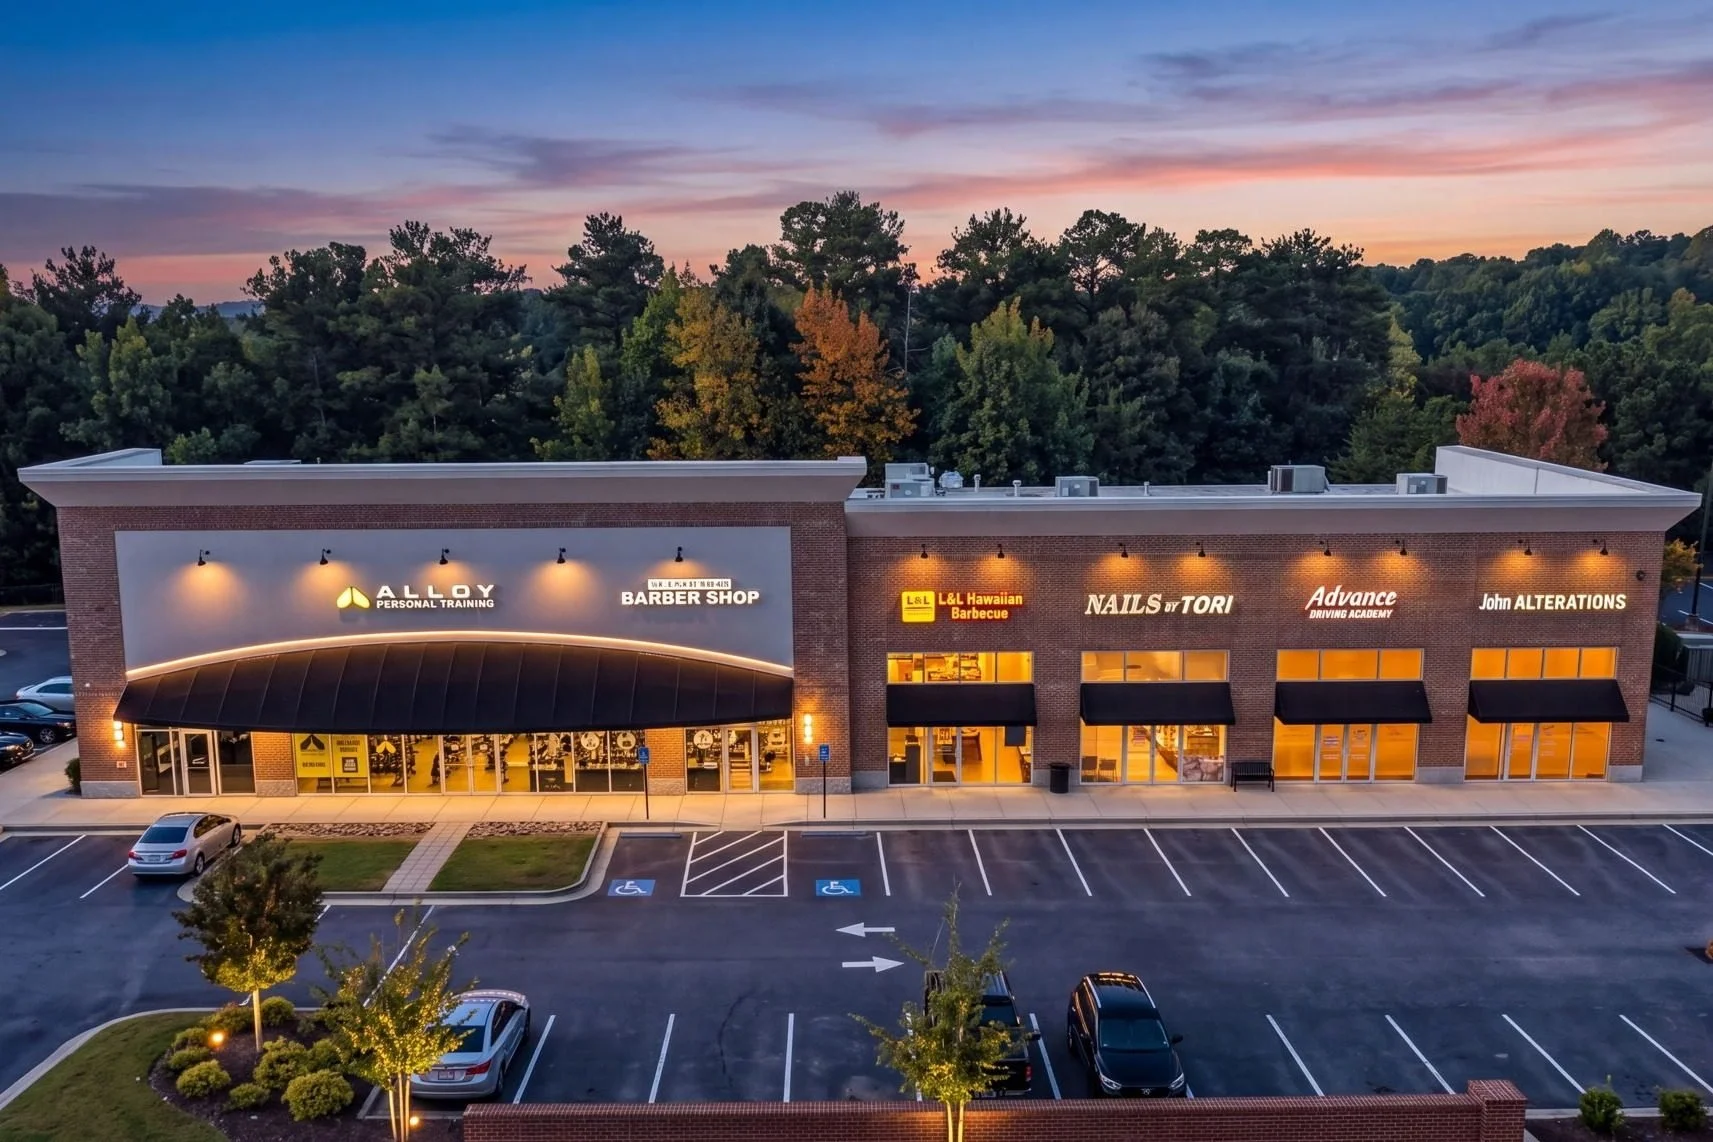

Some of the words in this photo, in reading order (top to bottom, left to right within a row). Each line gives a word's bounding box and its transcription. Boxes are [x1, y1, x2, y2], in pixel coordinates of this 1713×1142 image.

[376, 584, 495, 599] ALLOY
[621, 591, 701, 605] BARBER
[706, 590, 760, 605] SHOP
[938, 592, 964, 605] L&L
[967, 591, 1023, 605] Hawaiian
[1304, 584, 1397, 611] Advance
[376, 600, 437, 609] PERSONAL
[439, 599, 495, 608] TRAINING
[906, 595, 930, 605] L&L
[1084, 593, 1162, 615] NAILS
[1181, 594, 1234, 614] TORI
[1479, 593, 1511, 610] John
[1513, 594, 1627, 610] ALTERATIONS
[951, 606, 1009, 620] Barbecue
[1309, 609, 1347, 619] DRIVING
[1348, 609, 1393, 619] ACADEMY
